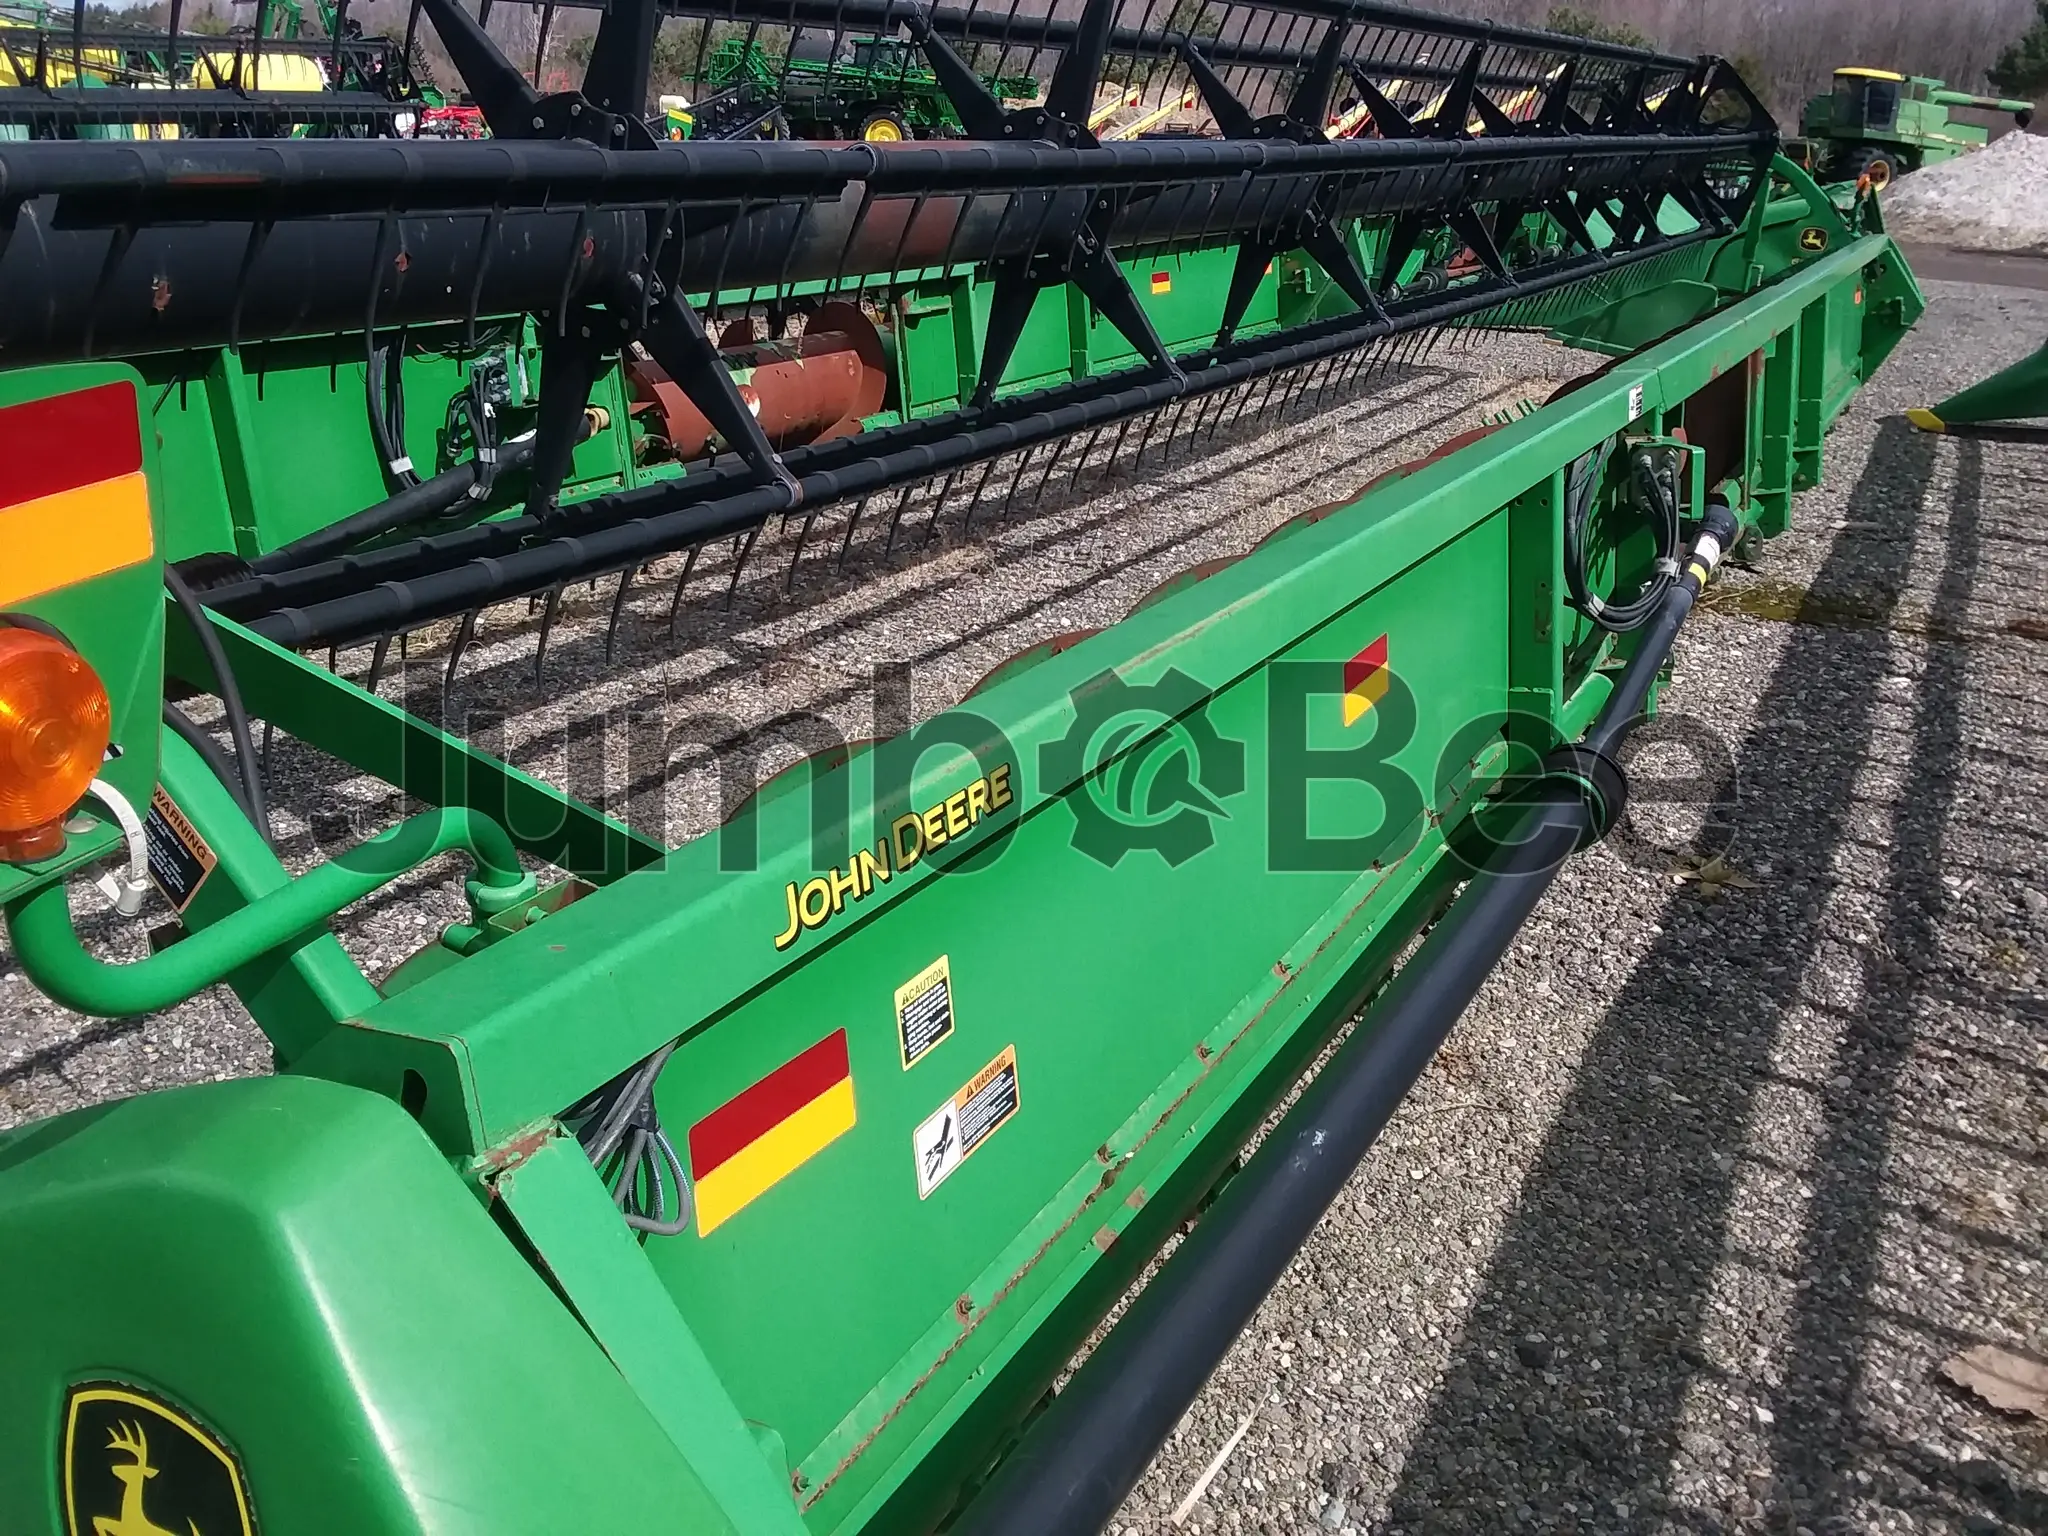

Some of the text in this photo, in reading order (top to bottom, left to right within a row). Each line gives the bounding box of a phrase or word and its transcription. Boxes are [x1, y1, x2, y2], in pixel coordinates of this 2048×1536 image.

[153, 787, 206, 860] WARNING
[774, 763, 1014, 951] JOHN DEERE
[908, 966, 945, 1001] CAUTION
[973, 1054, 1007, 1090] WARNING
